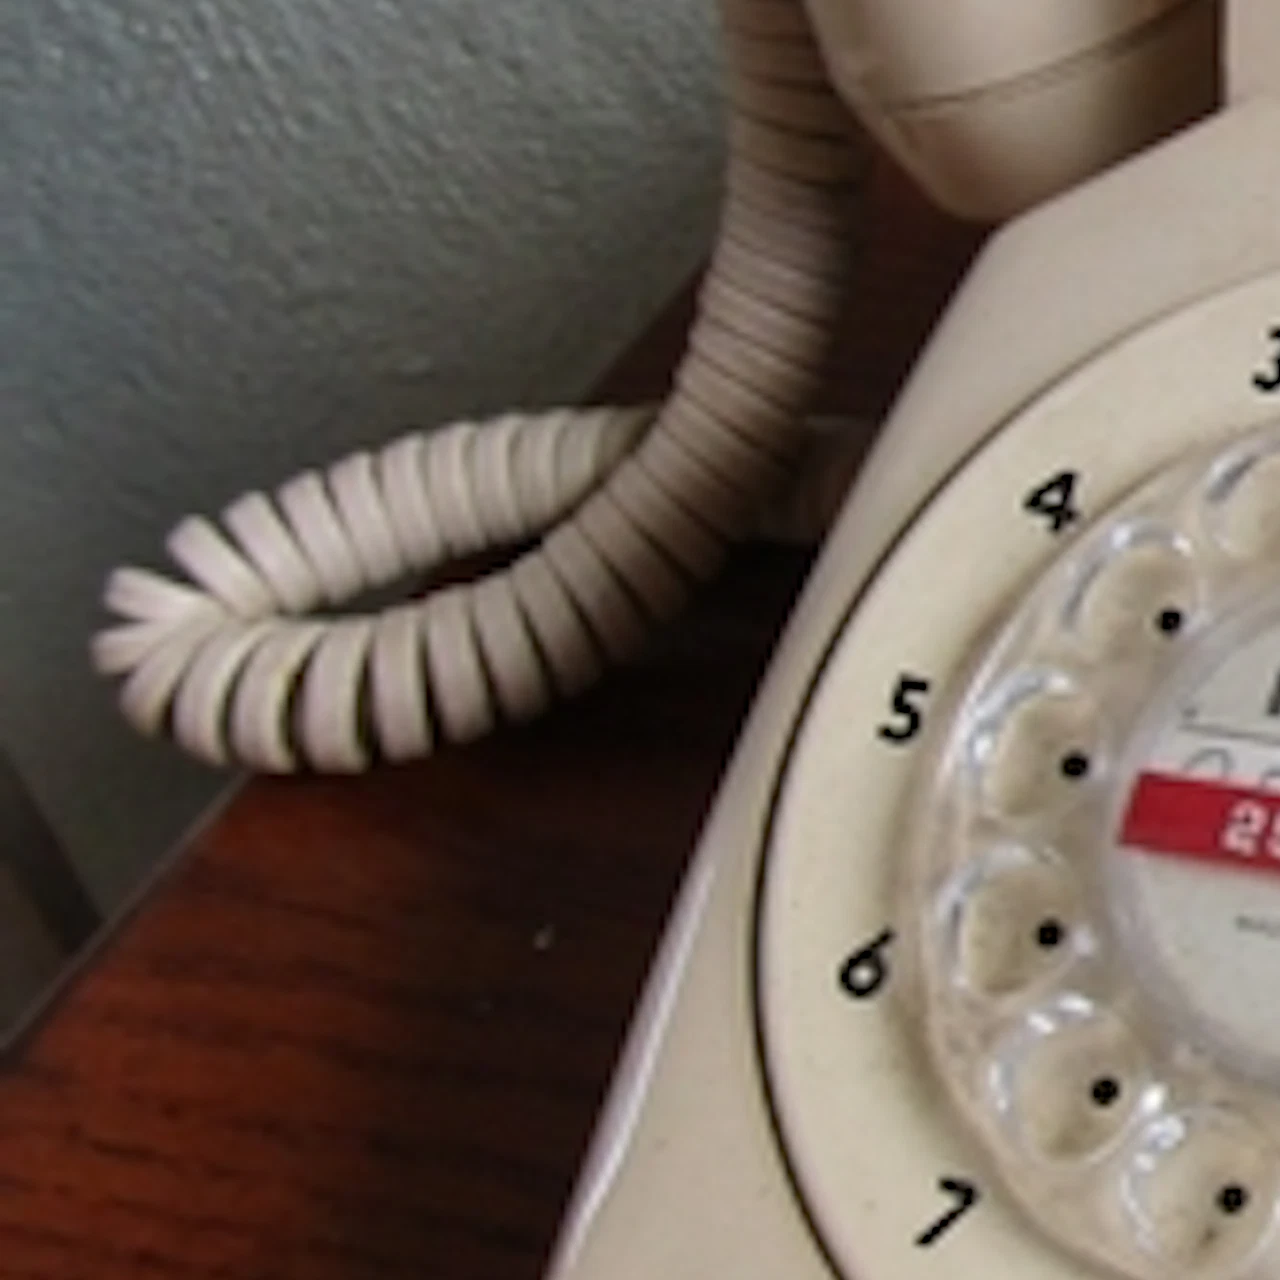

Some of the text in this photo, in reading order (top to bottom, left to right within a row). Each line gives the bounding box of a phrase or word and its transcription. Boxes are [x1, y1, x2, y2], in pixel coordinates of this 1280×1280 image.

[1022, 470, 1083, 537] 4
[877, 673, 932, 747] 5
[837, 924, 898, 1001] 6
[914, 1176, 982, 1248] 7
